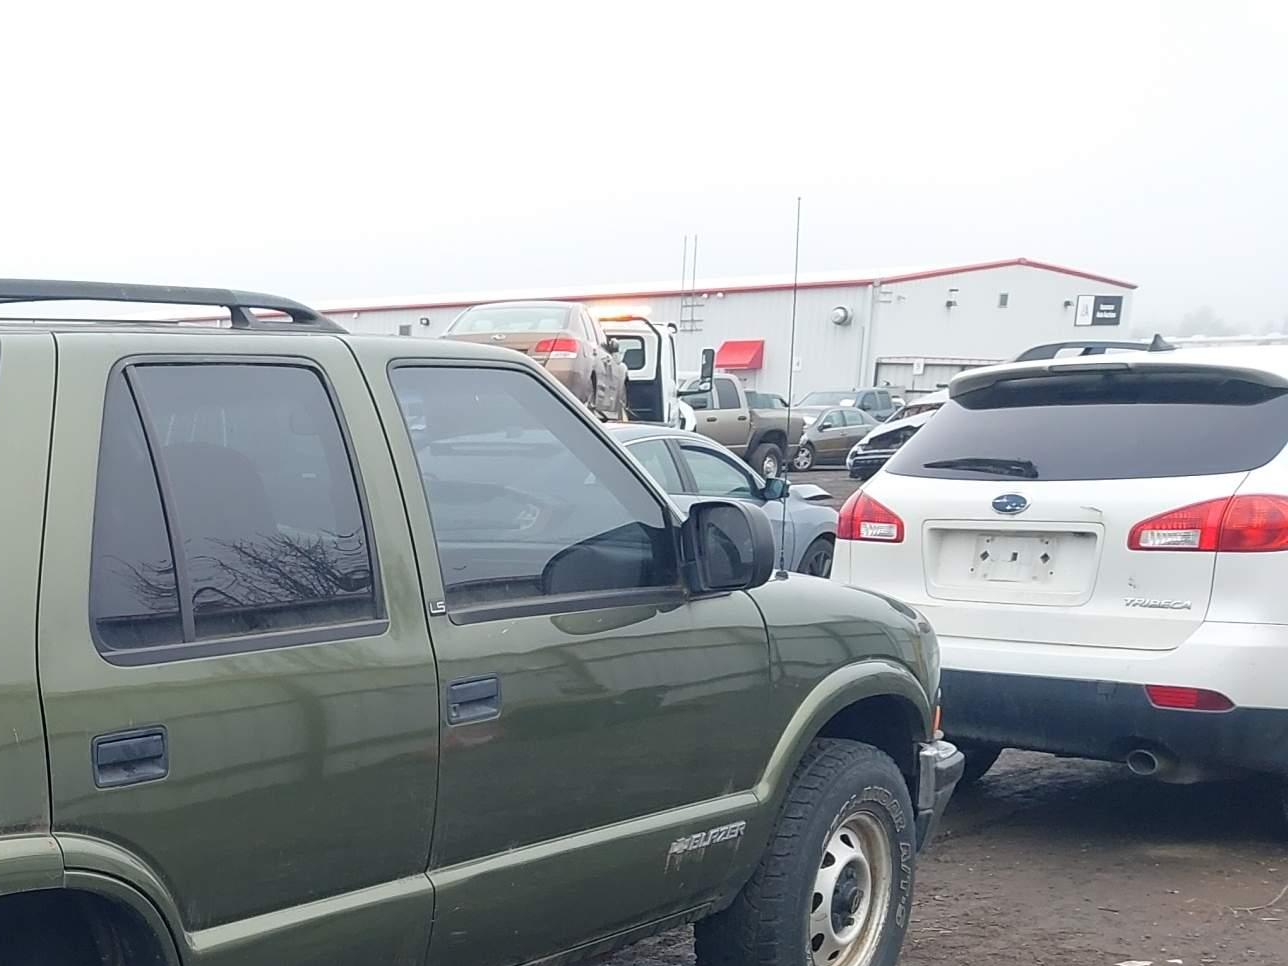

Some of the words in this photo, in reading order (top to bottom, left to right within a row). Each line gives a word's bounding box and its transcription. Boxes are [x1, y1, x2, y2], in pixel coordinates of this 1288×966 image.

[429, 601, 446, 614] LS
[1123, 598, 1192, 610] TRIBECA
[687, 821, 746, 851] BLAZER
